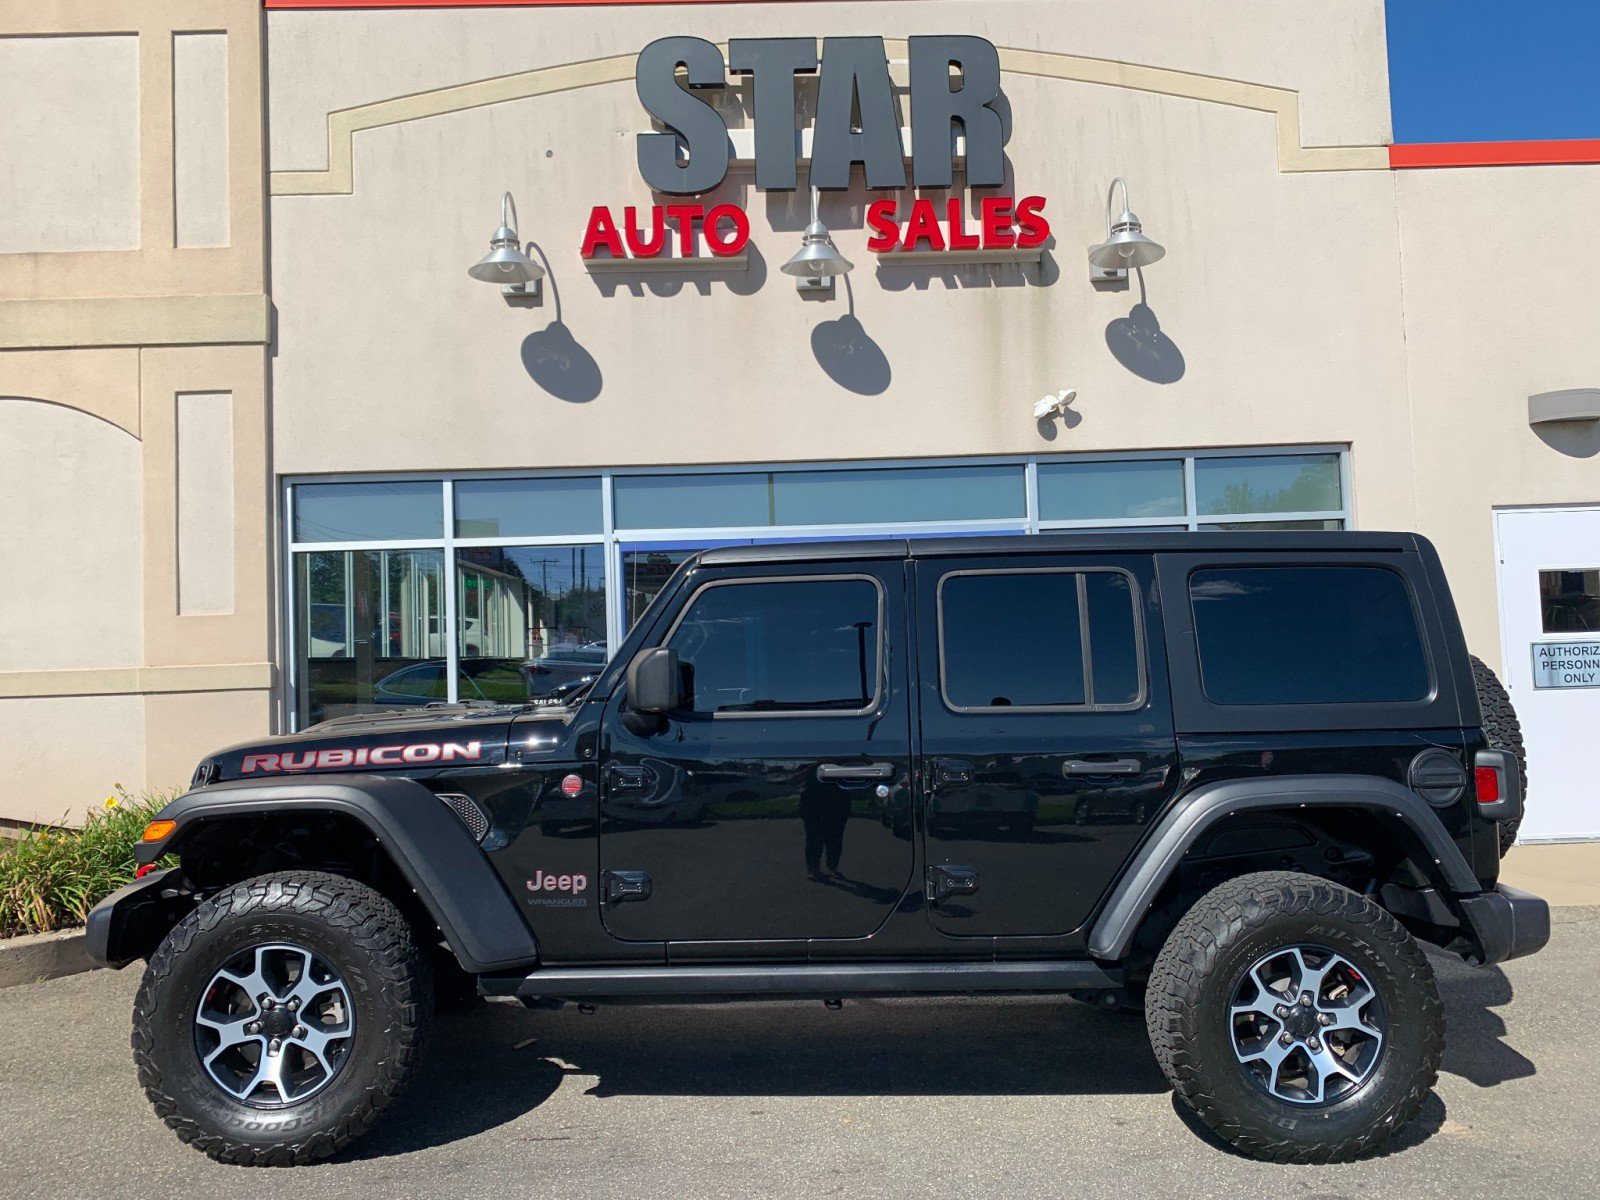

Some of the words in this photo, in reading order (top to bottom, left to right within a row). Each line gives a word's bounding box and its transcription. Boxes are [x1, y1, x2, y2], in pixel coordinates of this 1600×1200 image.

[636, 35, 1005, 194] STAR
[581, 204, 750, 259] AUTO
[867, 196, 1050, 253] SALES
[1564, 673, 1595, 683] ONLY
[241, 741, 481, 773] RUBICON
[526, 870, 587, 894] Jeep
